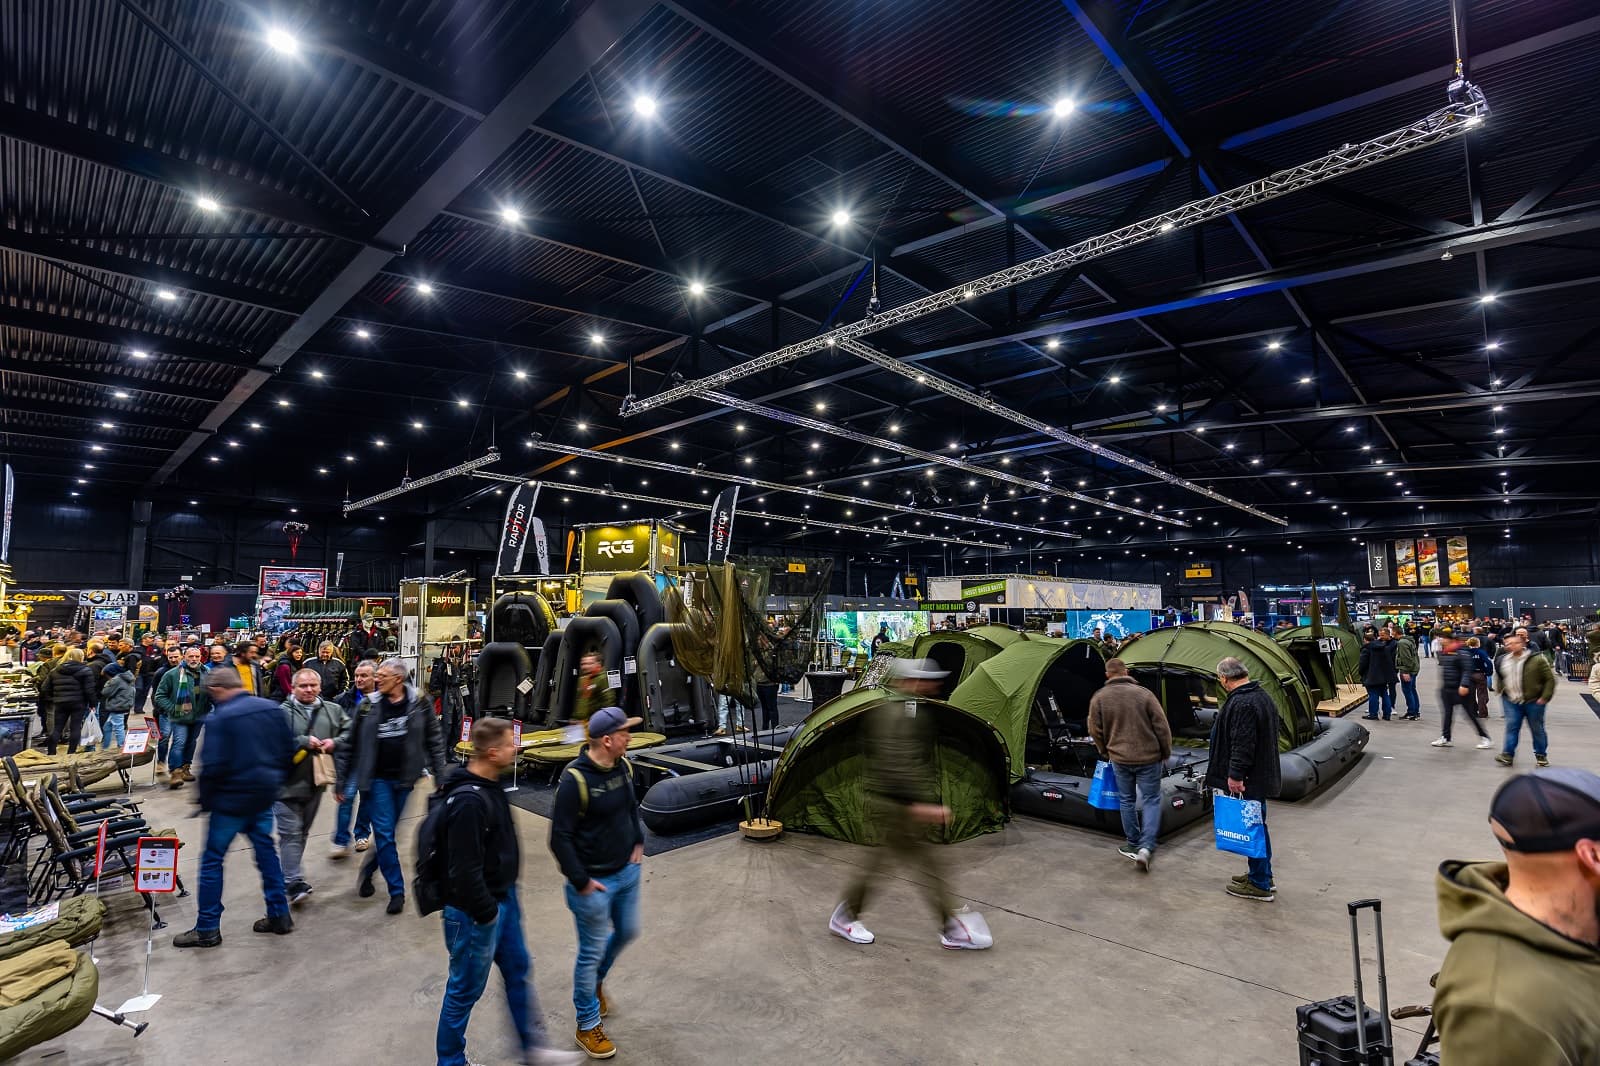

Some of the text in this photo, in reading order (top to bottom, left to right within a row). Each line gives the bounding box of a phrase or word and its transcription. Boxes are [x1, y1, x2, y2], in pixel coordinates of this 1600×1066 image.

[508, 503, 526, 548] RAPTOR
[715, 510, 728, 551] RAPTOR
[597, 539, 634, 558] RCG
[1374, 556, 1383, 571] Food
[80, 590, 136, 604] SOLAR
[431, 596, 461, 604] RAPTOR
[1216, 828, 1250, 842] SHIMANO
